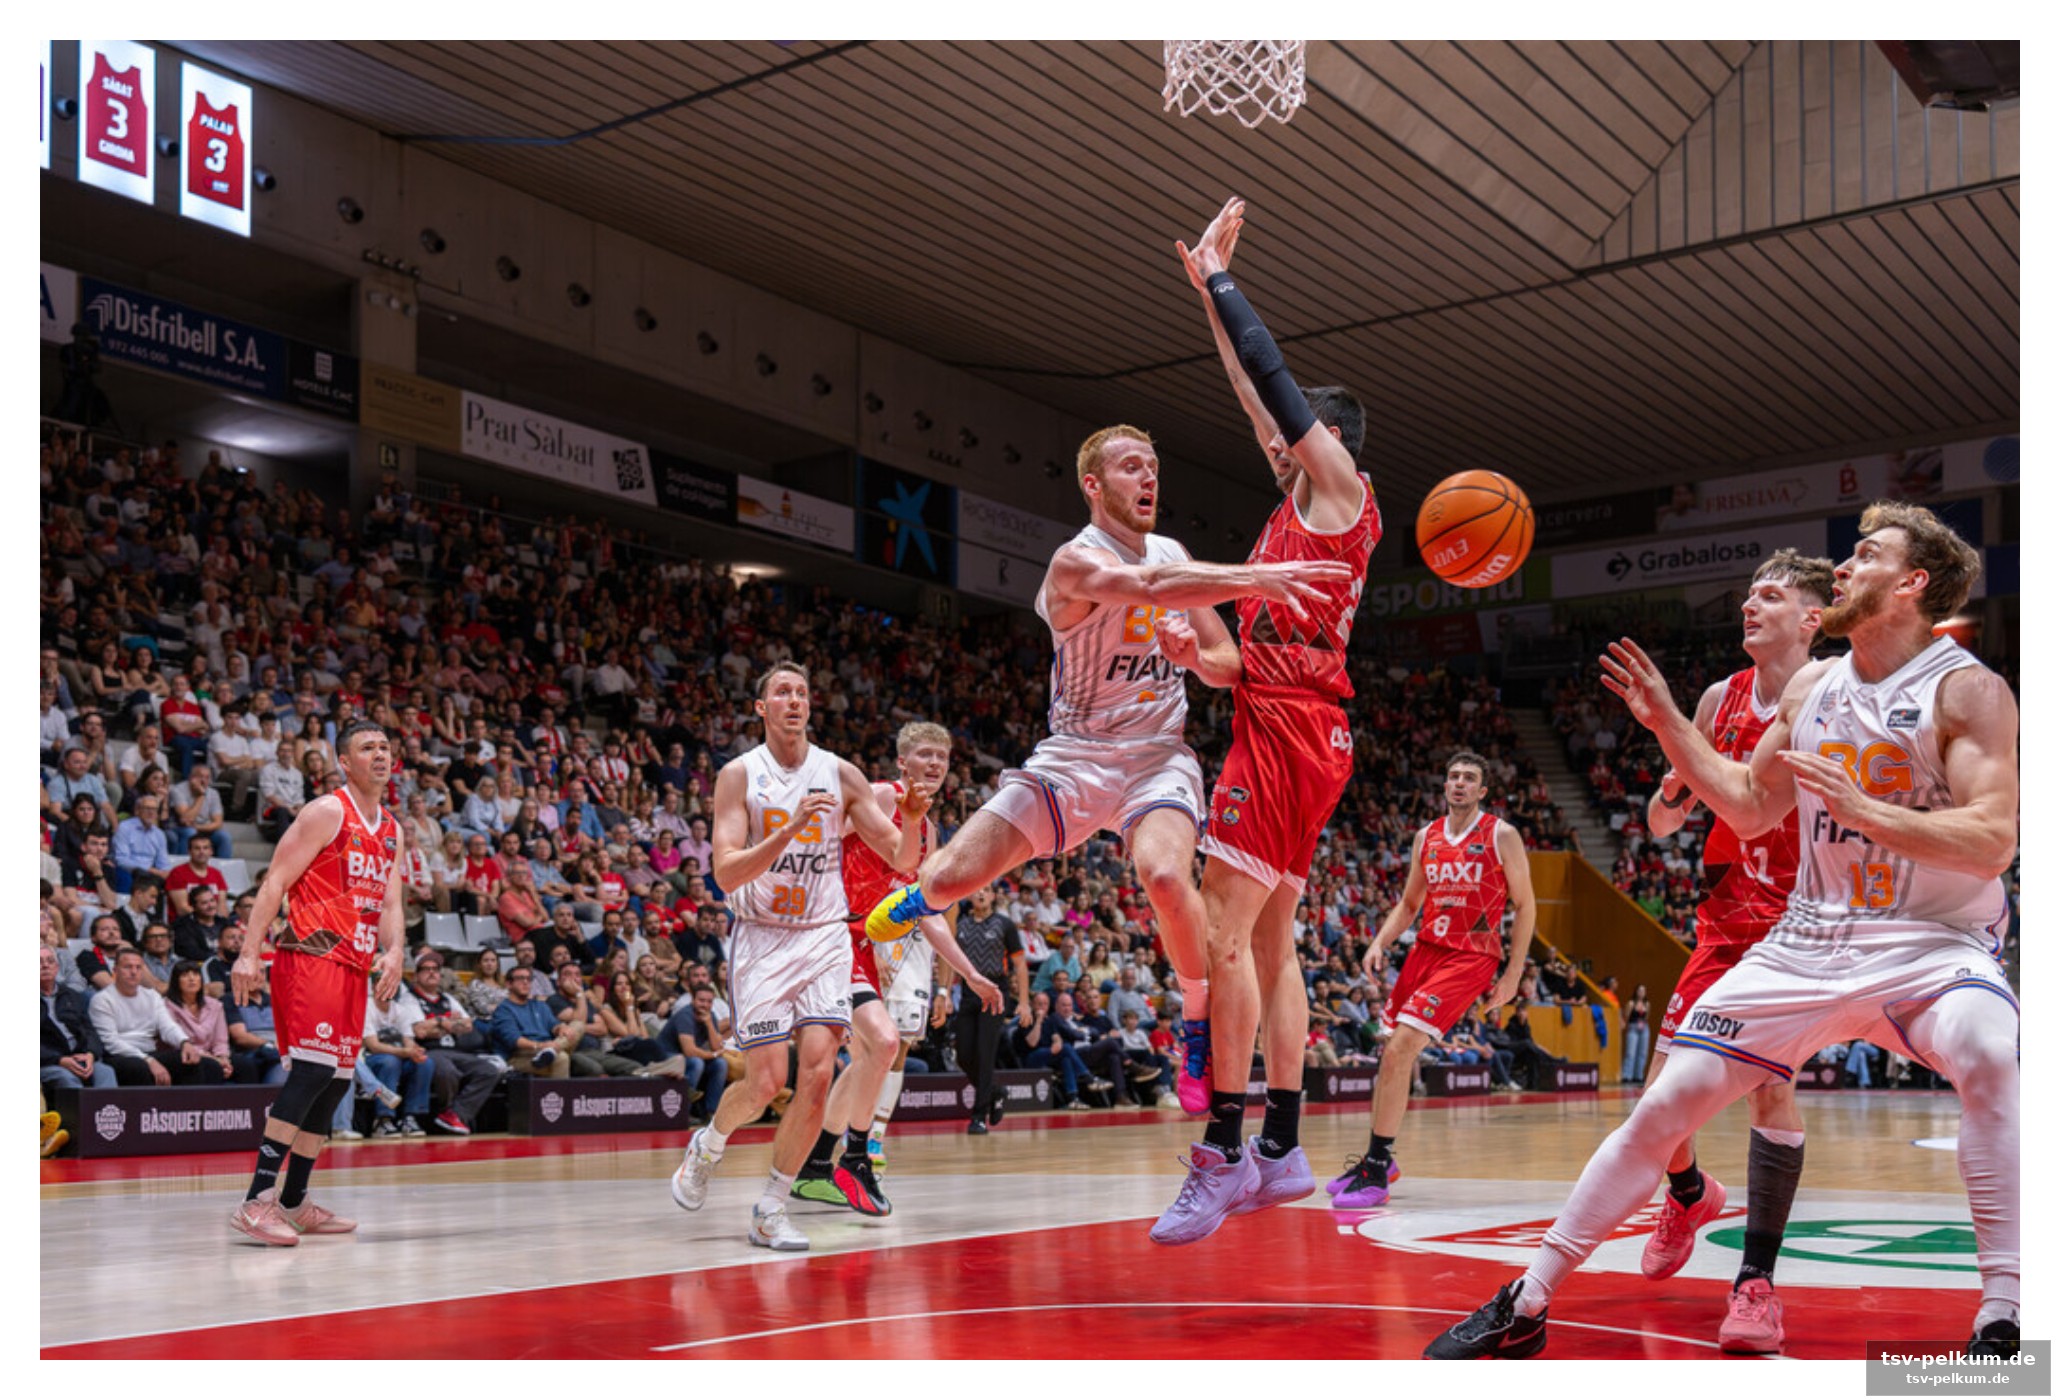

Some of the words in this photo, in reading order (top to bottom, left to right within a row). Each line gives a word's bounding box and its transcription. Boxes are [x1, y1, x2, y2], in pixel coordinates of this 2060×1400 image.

[106, 98, 129, 139] 3
[199, 113, 234, 136] PALAU
[204, 138, 228, 173] 3
[223, 329, 266, 372] S.A.
[466, 400, 517, 445] Prat
[1639, 541, 1761, 572] Grabalosa
[348, 851, 394, 884] BAX
[1426, 862, 1483, 884] BAXI
[772, 885, 807, 916] 29
[1849, 862, 1896, 910] 13
[353, 922, 378, 954] 55
[1433, 914, 1451, 937] 8
[748, 1019, 780, 1036] YOSOY
[1690, 1011, 1745, 1040] YOSOY
[140, 1107, 203, 1135] BÀSQUET
[203, 1109, 252, 1131] GIRONA
